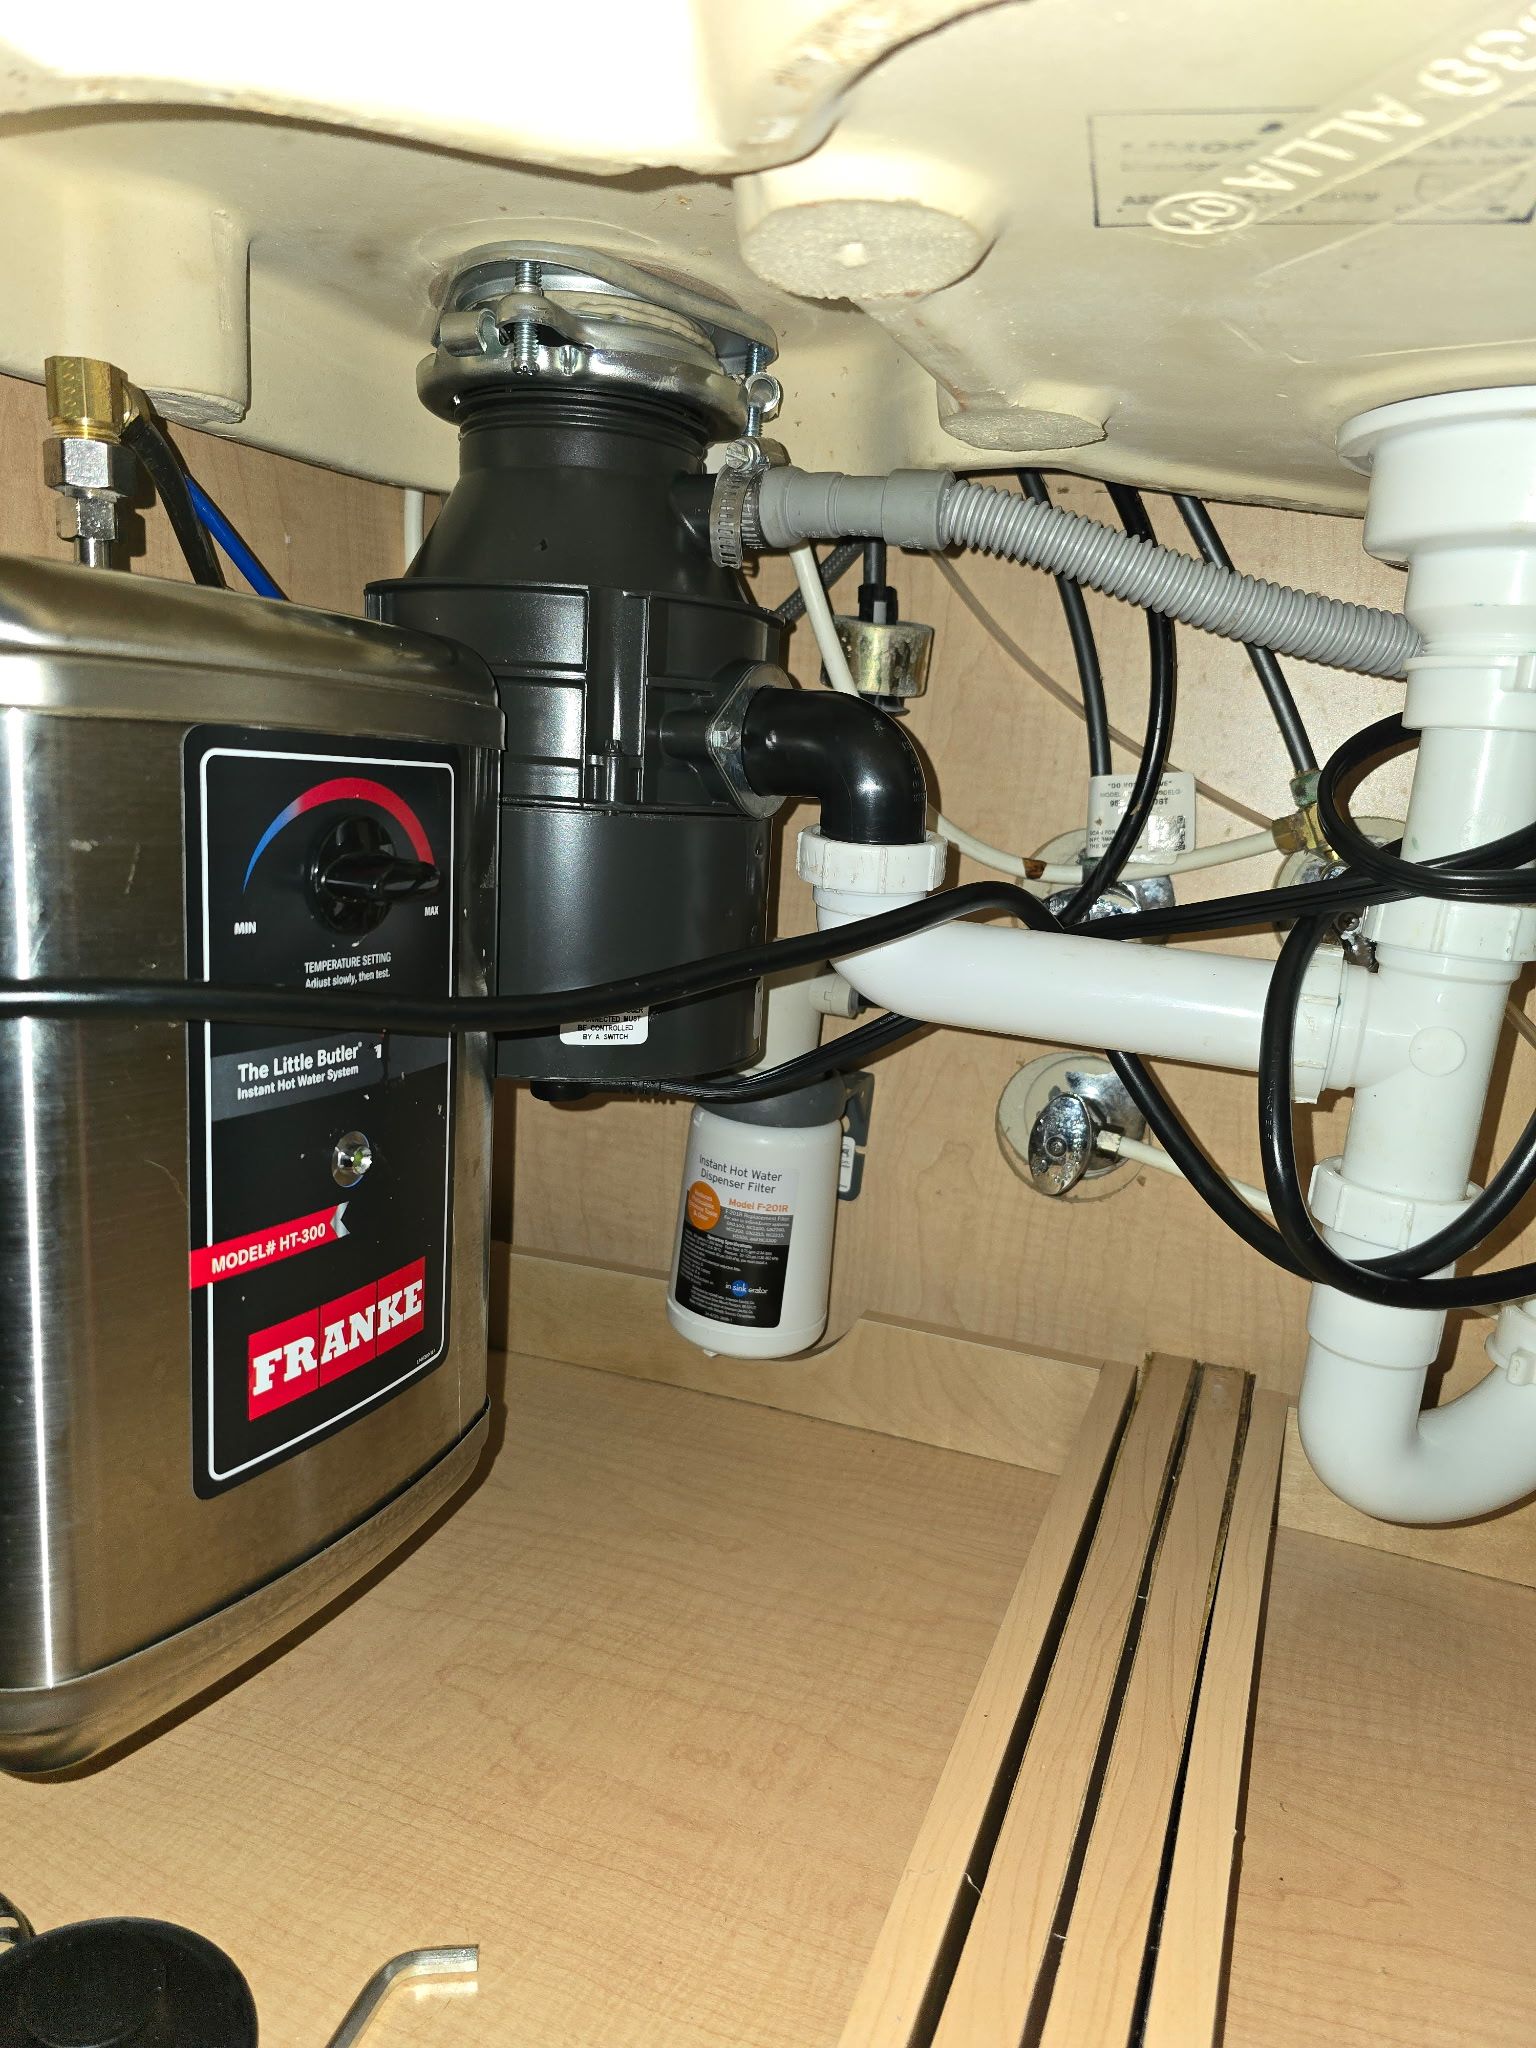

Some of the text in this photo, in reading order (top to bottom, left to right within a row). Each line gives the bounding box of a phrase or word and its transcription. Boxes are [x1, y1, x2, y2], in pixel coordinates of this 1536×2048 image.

[1221, 92, 1427, 191] ALLIA
[424, 904, 439, 917] MAX
[233, 920, 257, 936] MIN
[304, 951, 392, 974] TEMPERATURE SETTING
[305, 967, 391, 989] Adjust slowly, then test.
[237, 1061, 270, 1083] The
[273, 1052, 314, 1077] Little
[237, 1065, 359, 1101] Instant Hot Water System
[700, 1167, 777, 1194] Dispenser Filter
[729, 1164, 748, 1178] Hot
[751, 1169, 783, 1182] Water
[728, 1198, 789, 1213] Model F-201R
[211, 1222, 326, 1275] MODEL# HT-300
[252, 1278, 424, 1397] FRANKE
